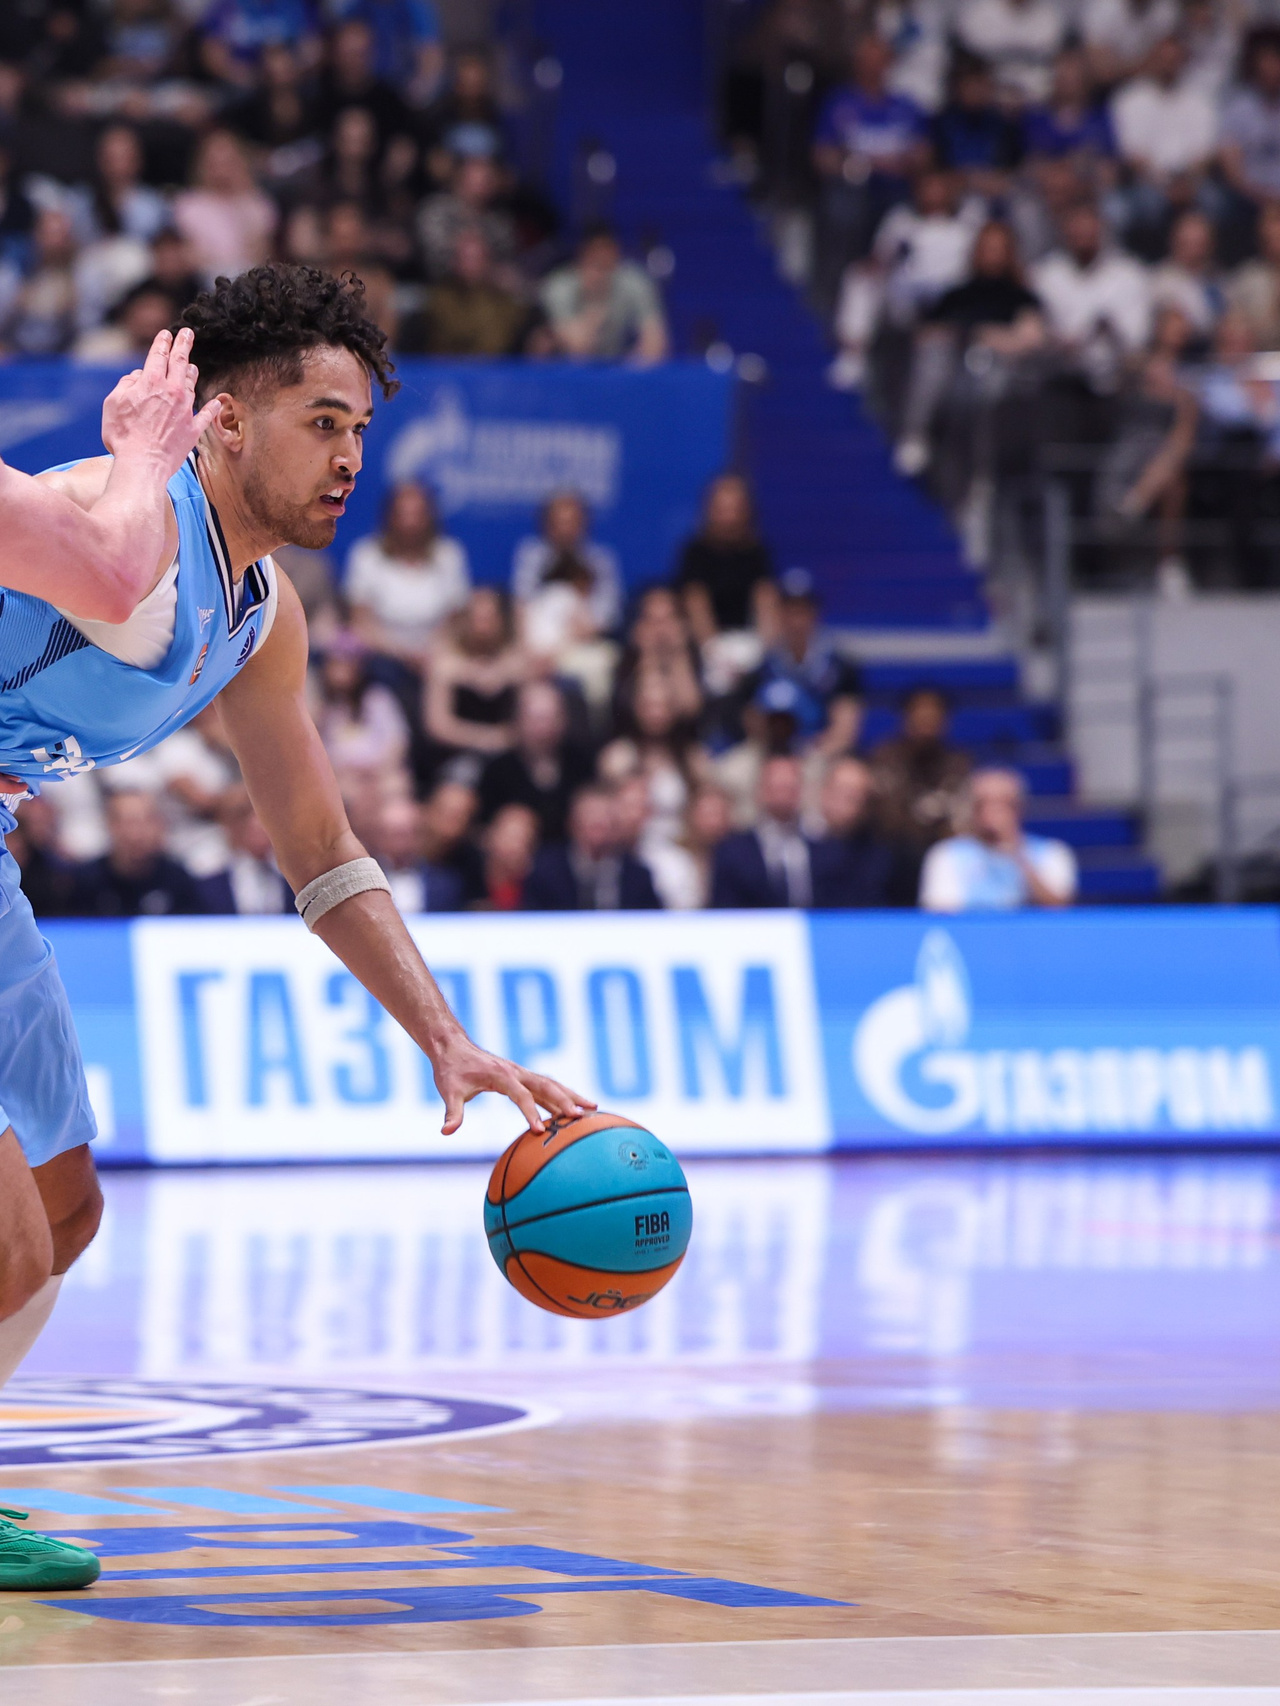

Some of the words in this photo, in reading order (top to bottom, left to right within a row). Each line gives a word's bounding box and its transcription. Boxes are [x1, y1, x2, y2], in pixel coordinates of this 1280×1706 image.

[978, 1046, 1271, 1133] ГАЗПРОМ
[634, 1211, 670, 1237] FIBA
[634, 1234, 670, 1248] APPROVED
